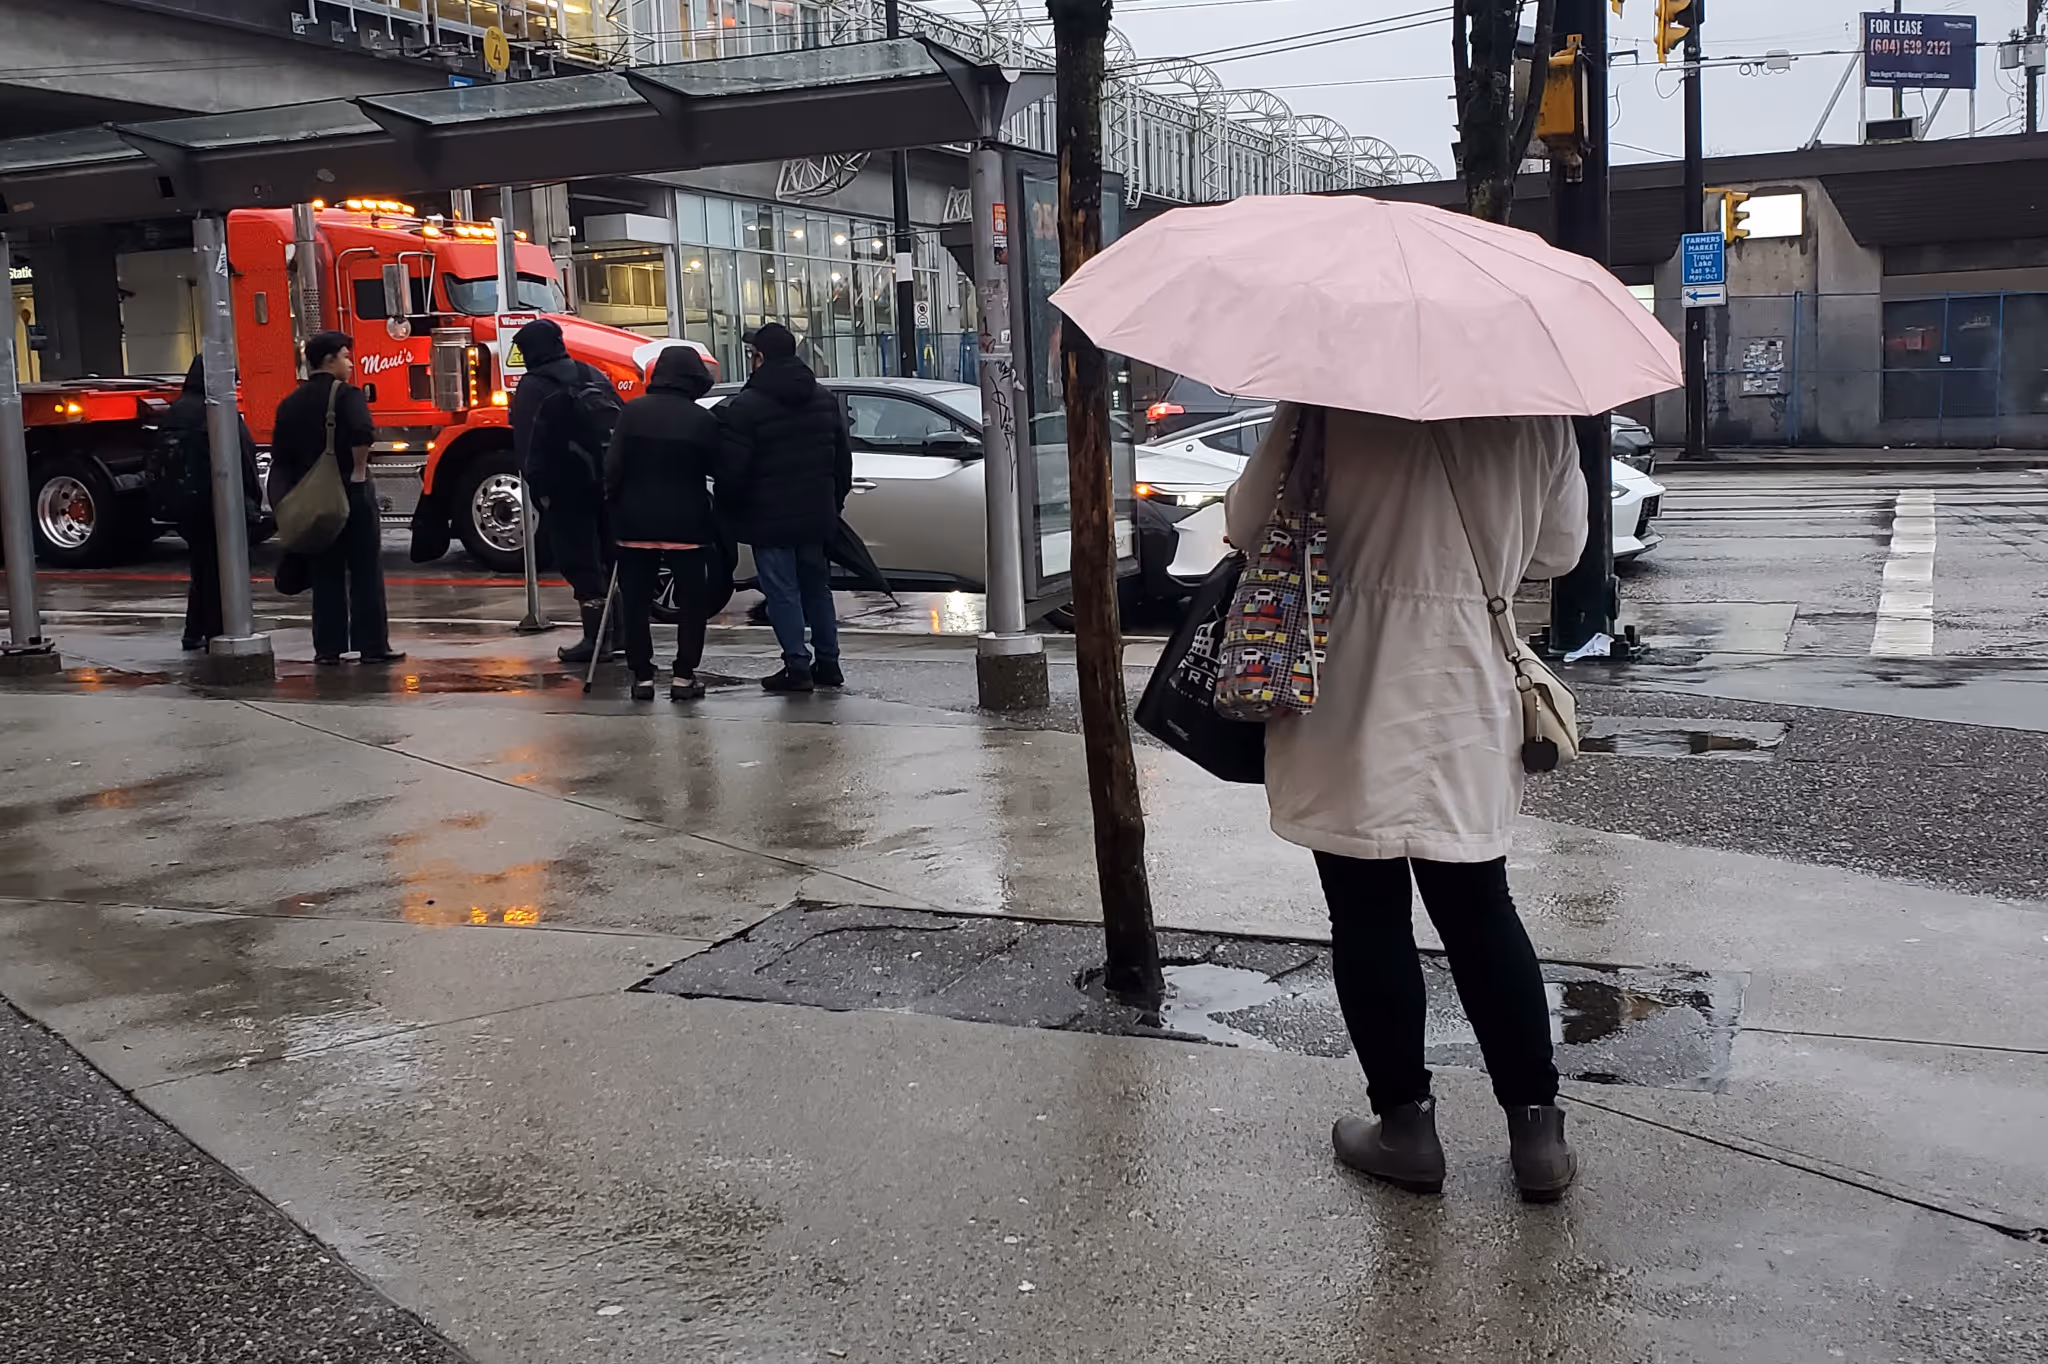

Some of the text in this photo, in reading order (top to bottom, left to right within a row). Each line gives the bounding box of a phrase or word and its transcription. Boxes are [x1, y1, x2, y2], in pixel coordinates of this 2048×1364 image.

[1870, 19, 1923, 35] FOR LEASE
[1870, 38, 1900, 56] (604)
[493, 43, 502, 66] 4
[1686, 236, 1720, 244] FARMERS
[1688, 244, 1718, 252] MARKET
[1688, 273, 1718, 282] May-Oct
[360, 347, 415, 375] Maui's
[617, 380, 634, 391] 007
